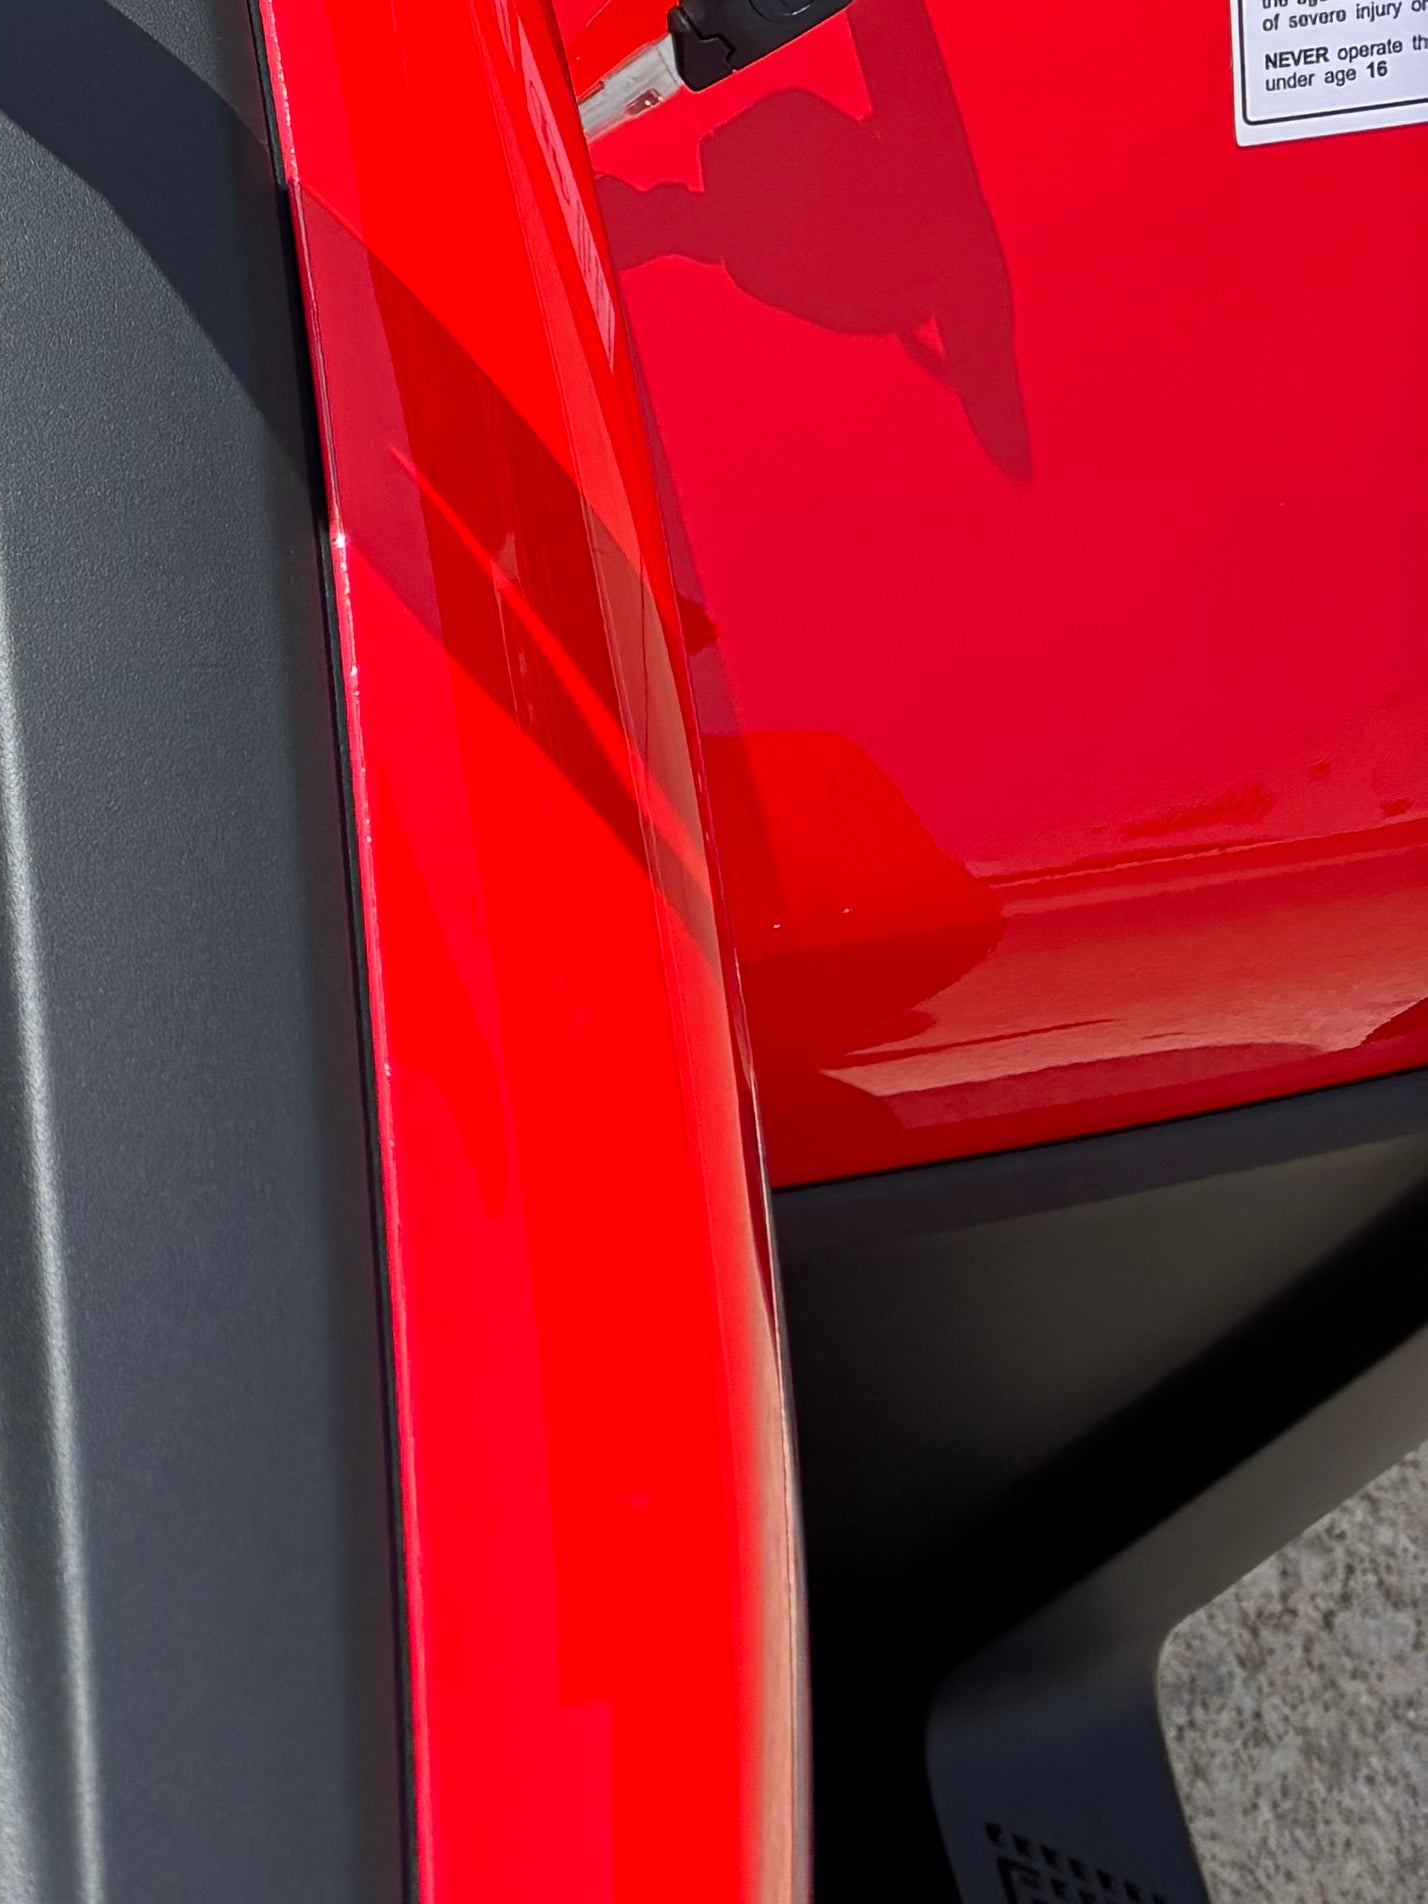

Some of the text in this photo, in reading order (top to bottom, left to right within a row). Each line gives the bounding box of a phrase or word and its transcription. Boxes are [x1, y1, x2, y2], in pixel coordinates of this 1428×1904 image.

[1262, 13, 1279, 31] of
[1289, 9, 1346, 28] severe
[1356, 1, 1402, 22] injury
[1265, 46, 1329, 70] NEVER
[1337, 38, 1402, 63] operate
[1265, 61, 1387, 91] under age 16
